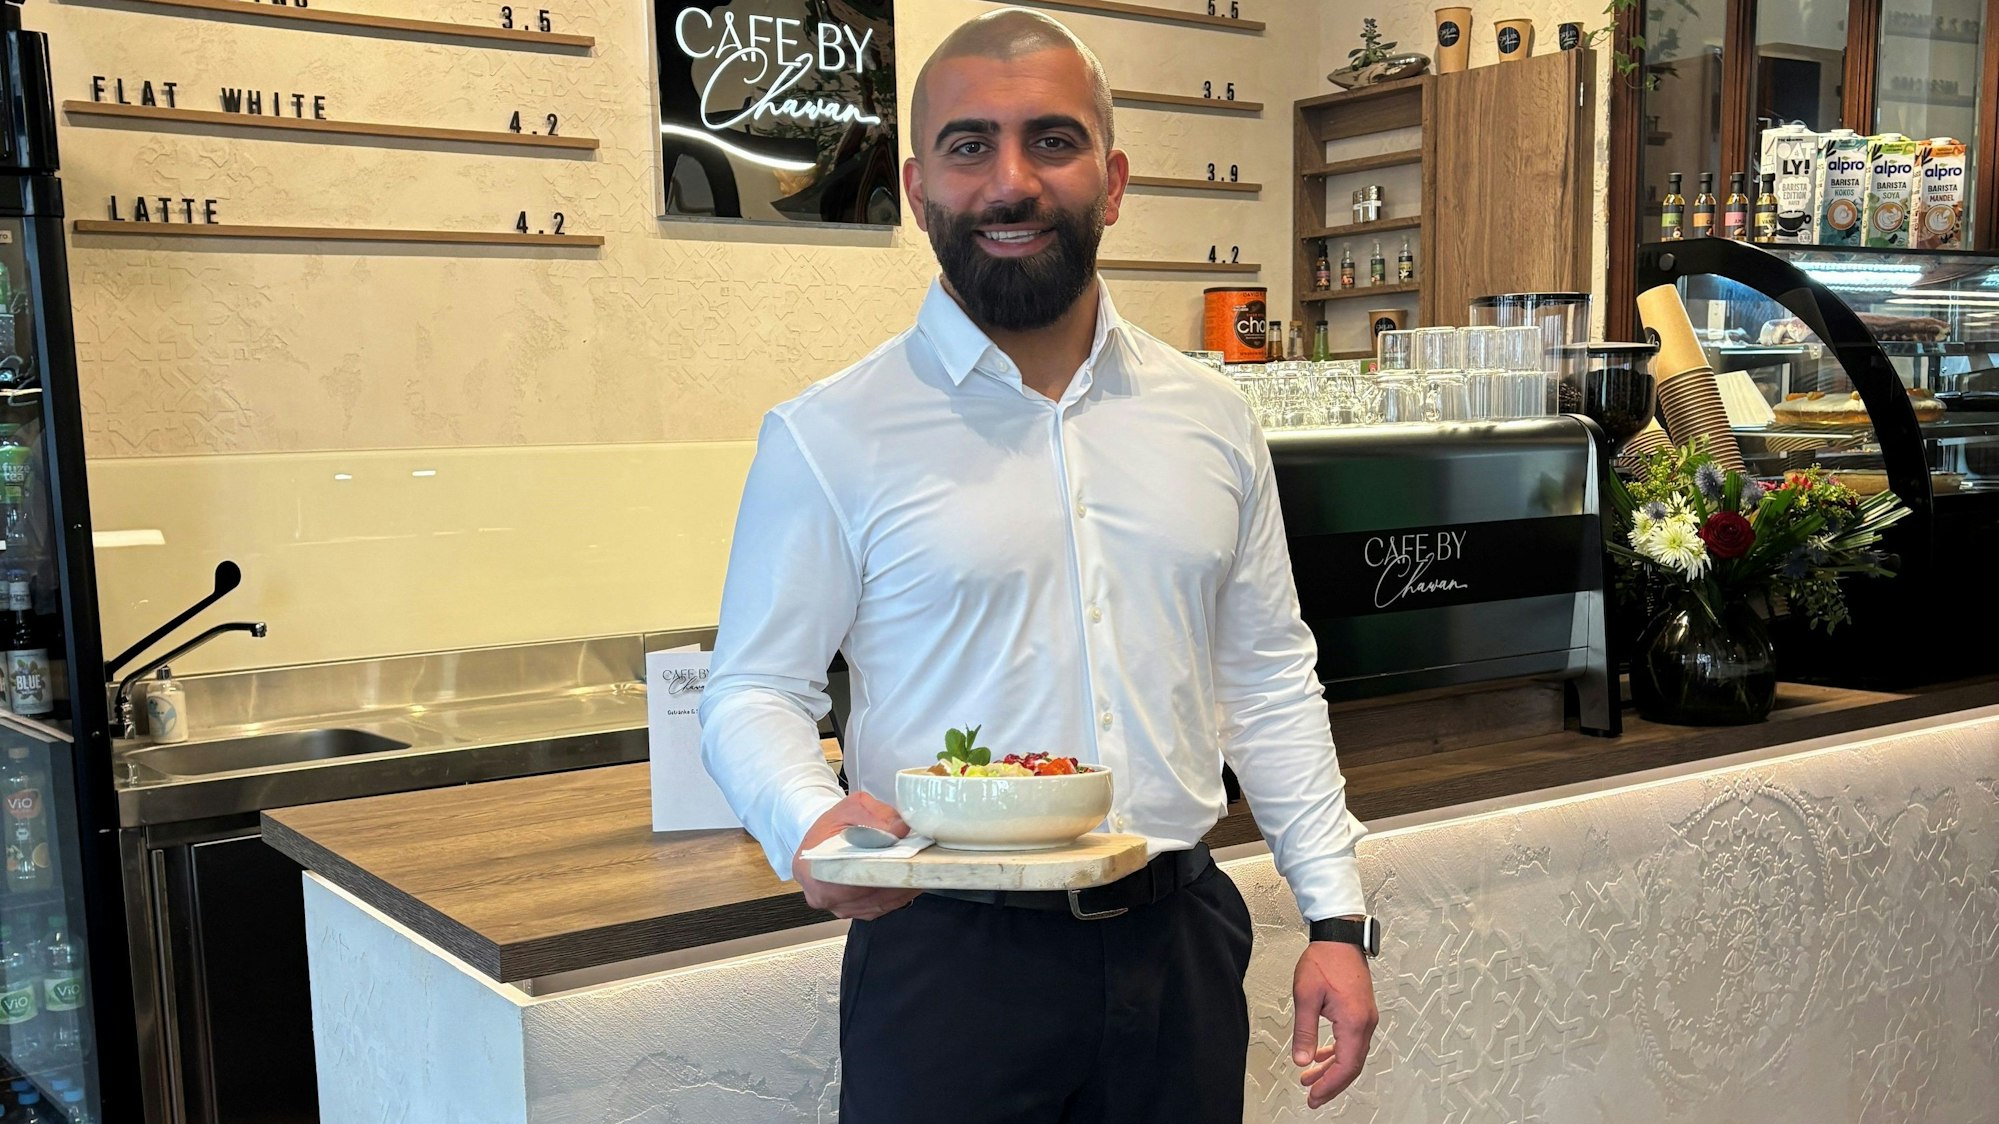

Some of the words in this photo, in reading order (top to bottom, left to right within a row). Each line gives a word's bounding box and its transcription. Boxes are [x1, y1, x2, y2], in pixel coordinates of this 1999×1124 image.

[1208, 0, 1239, 19] 5.5
[501, 6, 551, 32] 3.5
[675, 7, 801, 66] CAFE
[817, 22, 873, 73] BY
[700, 47, 881, 130] Chawan
[1204, 80, 1235, 101] 3.5
[93, 75, 177, 108] FLAT
[221, 87, 327, 120] WHITE
[509, 111, 559, 136] 4.2
[1207, 162, 1239, 183] 3.9
[1783, 160, 1811, 176] LY!
[1828, 157, 1865, 174] alpro
[1874, 161, 1912, 178] alpro
[1925, 164, 1963, 181] alpro
[1781, 182, 1808, 192] BARISTA
[1830, 178, 1860, 187] BARISTA
[1876, 182, 1907, 190] BARISTA
[1927, 184, 1958, 193] BARISTA
[1782, 191, 1808, 201] EDITION
[1834, 188, 1855, 197] KOKOS
[1882, 191, 1900, 200] SOYA
[1929, 194, 1955, 203] MANDEL
[110, 195, 219, 224] LATTE
[516, 210, 566, 235] 4.2
[1209, 245, 1240, 264] 4.2
[1365, 534, 1429, 567] CAFE
[1437, 530, 1467, 561] BY
[1374, 552, 1469, 609] Chawan
[16, 675, 42, 690] BLUE
[662, 668, 696, 681] CAFE
